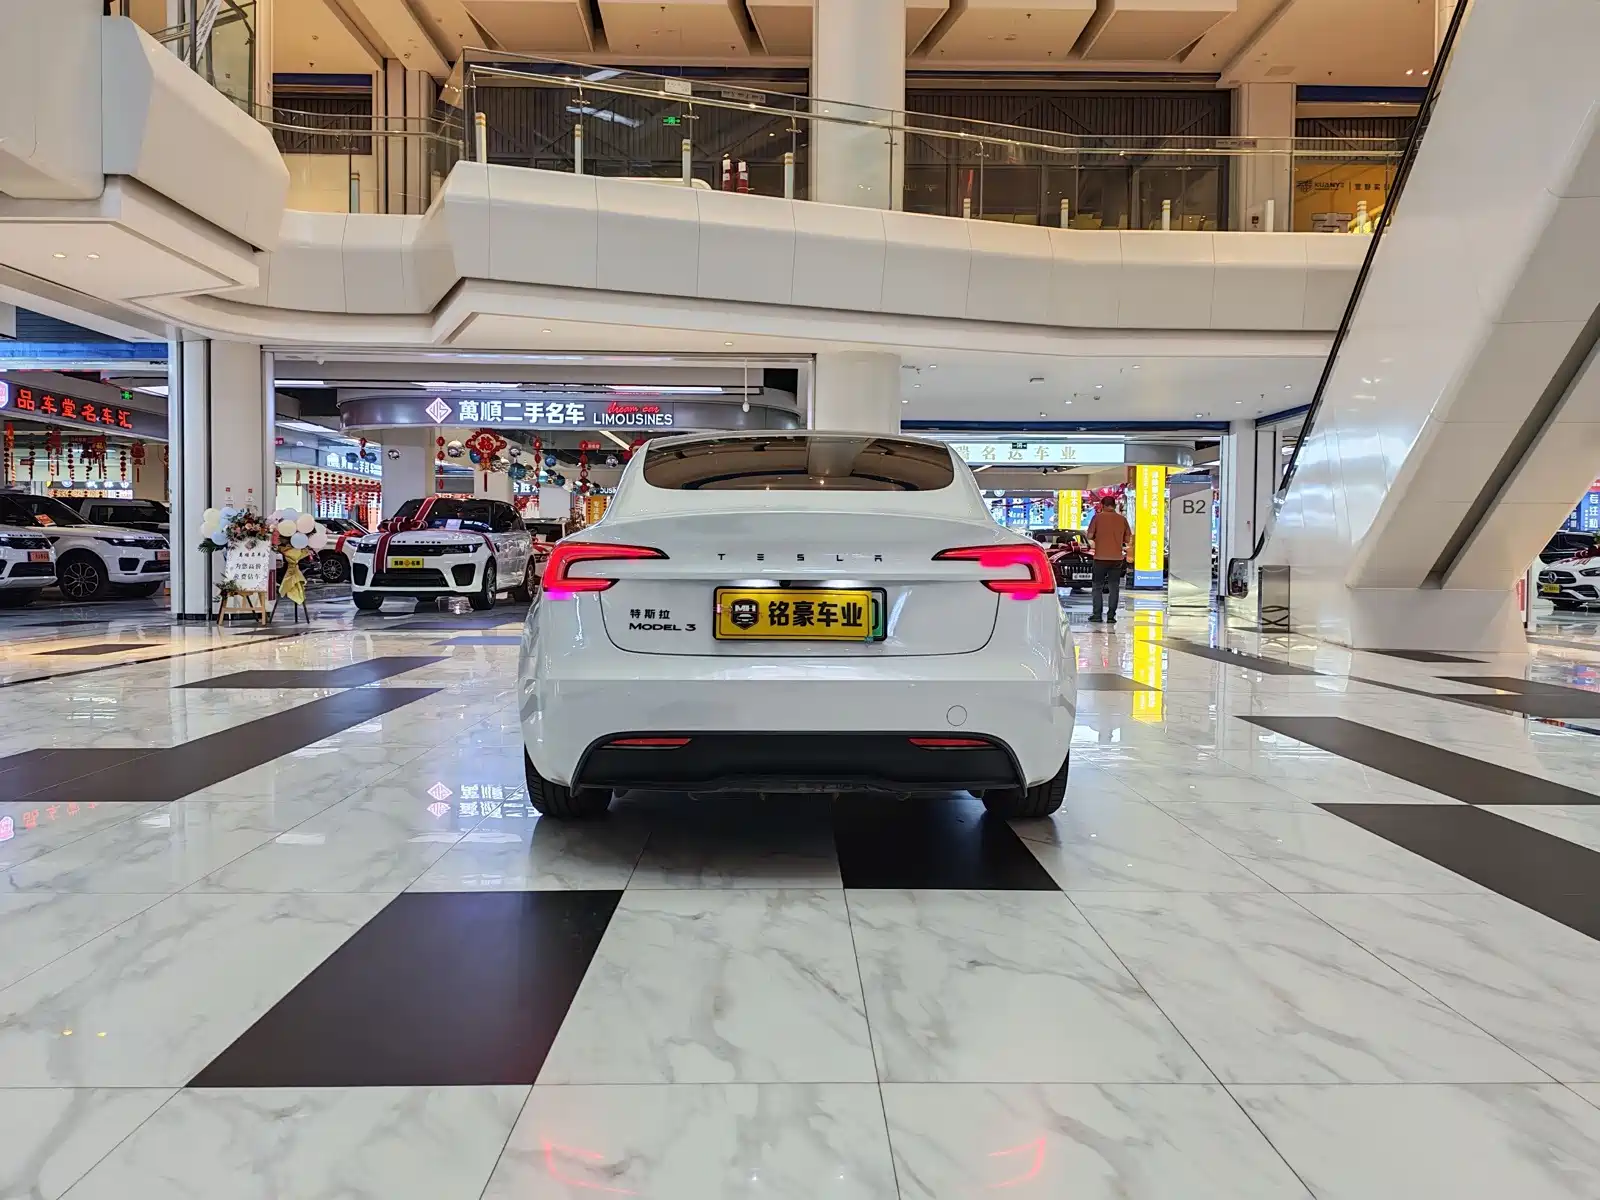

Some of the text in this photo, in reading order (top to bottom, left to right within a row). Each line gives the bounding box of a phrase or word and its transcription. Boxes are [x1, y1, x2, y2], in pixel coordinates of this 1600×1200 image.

[17, 389, 133, 428] 品车堂名车汇
[458, 400, 585, 425] 萬順二手名车
[606, 402, 639, 413] dream
[593, 413, 673, 425] LIMOUSINES
[1183, 500, 1206, 514] B2
[718, 553, 882, 562] TESLA
[630, 608, 670, 619] 特斯拉
[768, 600, 863, 628] 铭豪车业
[629, 622, 681, 631] MODEL
